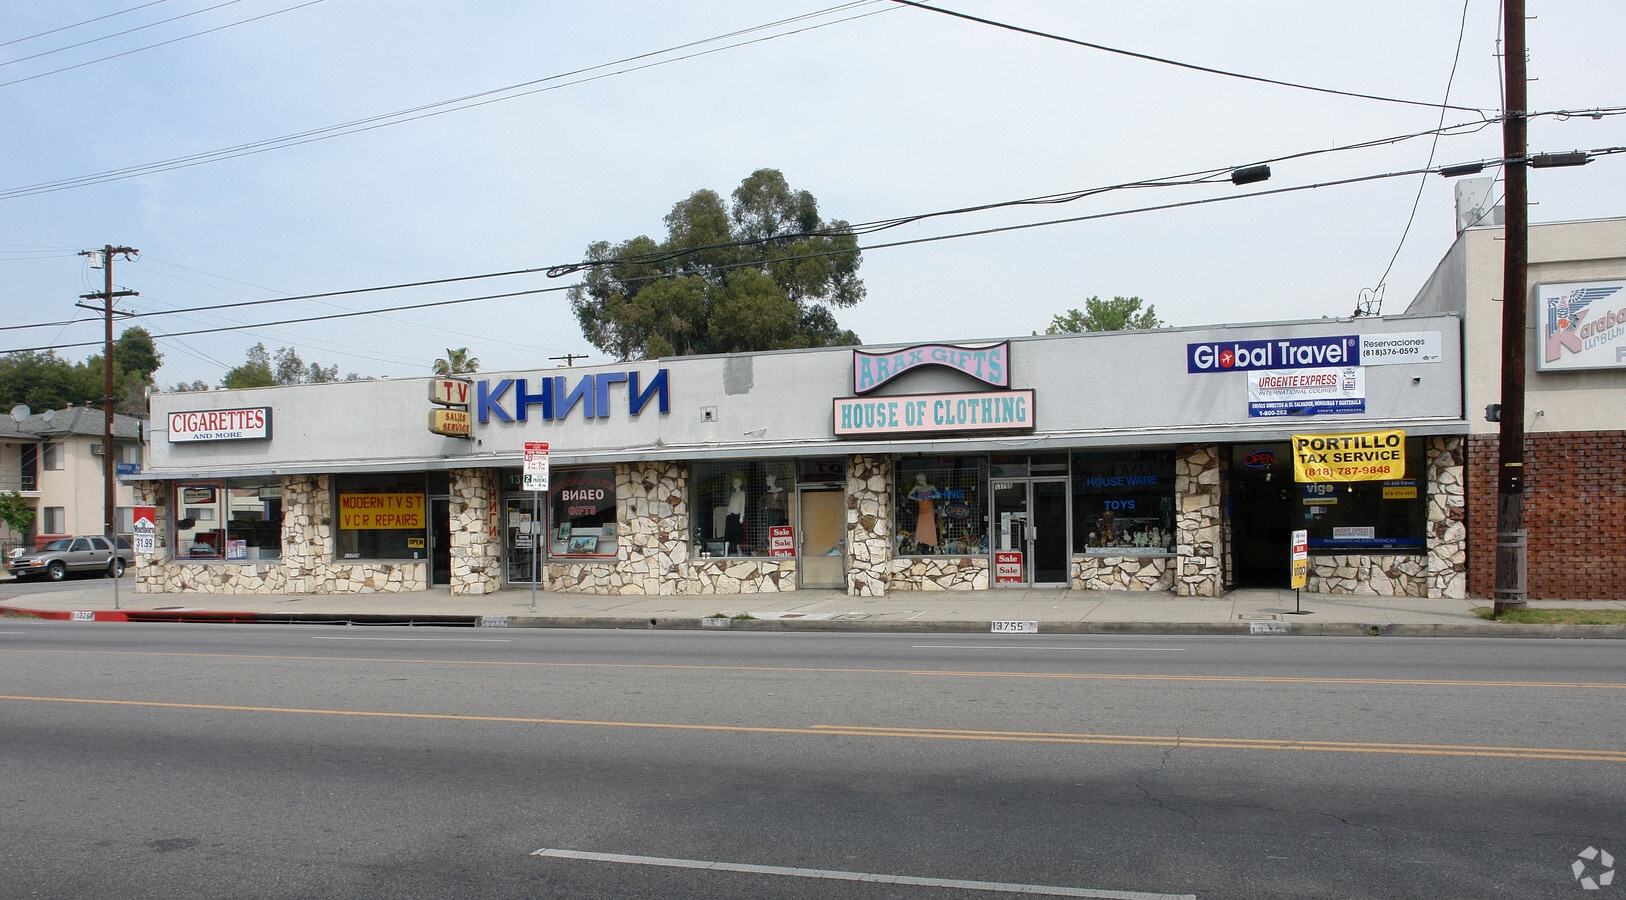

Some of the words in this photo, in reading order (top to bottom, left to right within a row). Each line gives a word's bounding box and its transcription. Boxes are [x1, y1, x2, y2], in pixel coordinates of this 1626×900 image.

[1363, 339, 1425, 348] Reservaciones
[1278, 339, 1347, 365] Travel
[1363, 347, 1419, 358] (818)376-0593
[859, 349, 924, 389] ARAX
[931, 348, 1003, 383] GIFTS
[1259, 376, 1299, 388] URGENTE
[1300, 374, 1337, 386] EXPRESS
[477, 369, 671, 424] КНИГИ
[445, 412, 467, 422] SALES
[841, 402, 899, 429] HOUSE
[905, 401, 927, 426] OF
[934, 397, 1026, 426] CLOTHING
[172, 409, 265, 433] CIGARETTES
[442, 422, 470, 434] SERVICE
[1297, 434, 1401, 452] PORTILLO
[1243, 452, 1276, 465] OPEN
[1298, 453, 1329, 464] TAX
[1333, 450, 1401, 463] SERVICE
[1304, 468, 1334, 479] (818)
[1338, 465, 1392, 476] 787-9848
[1086, 477, 1124, 487] HOUSE
[1126, 475, 1158, 485] WARE
[1306, 483, 1334, 495] vigo
[342, 496, 384, 509] MODERN
[1104, 500, 1135, 510] TOYS
[567, 505, 597, 516] GIFTS
[375, 514, 418, 526] REPAIRS
[773, 528, 790, 536] Sale
[136, 538, 153, 549] 31.99
[774, 539, 791, 547] Sale
[998, 554, 1018, 563] Sale
[999, 566, 1018, 574] Sale
[992, 621, 1023, 631] 13755
